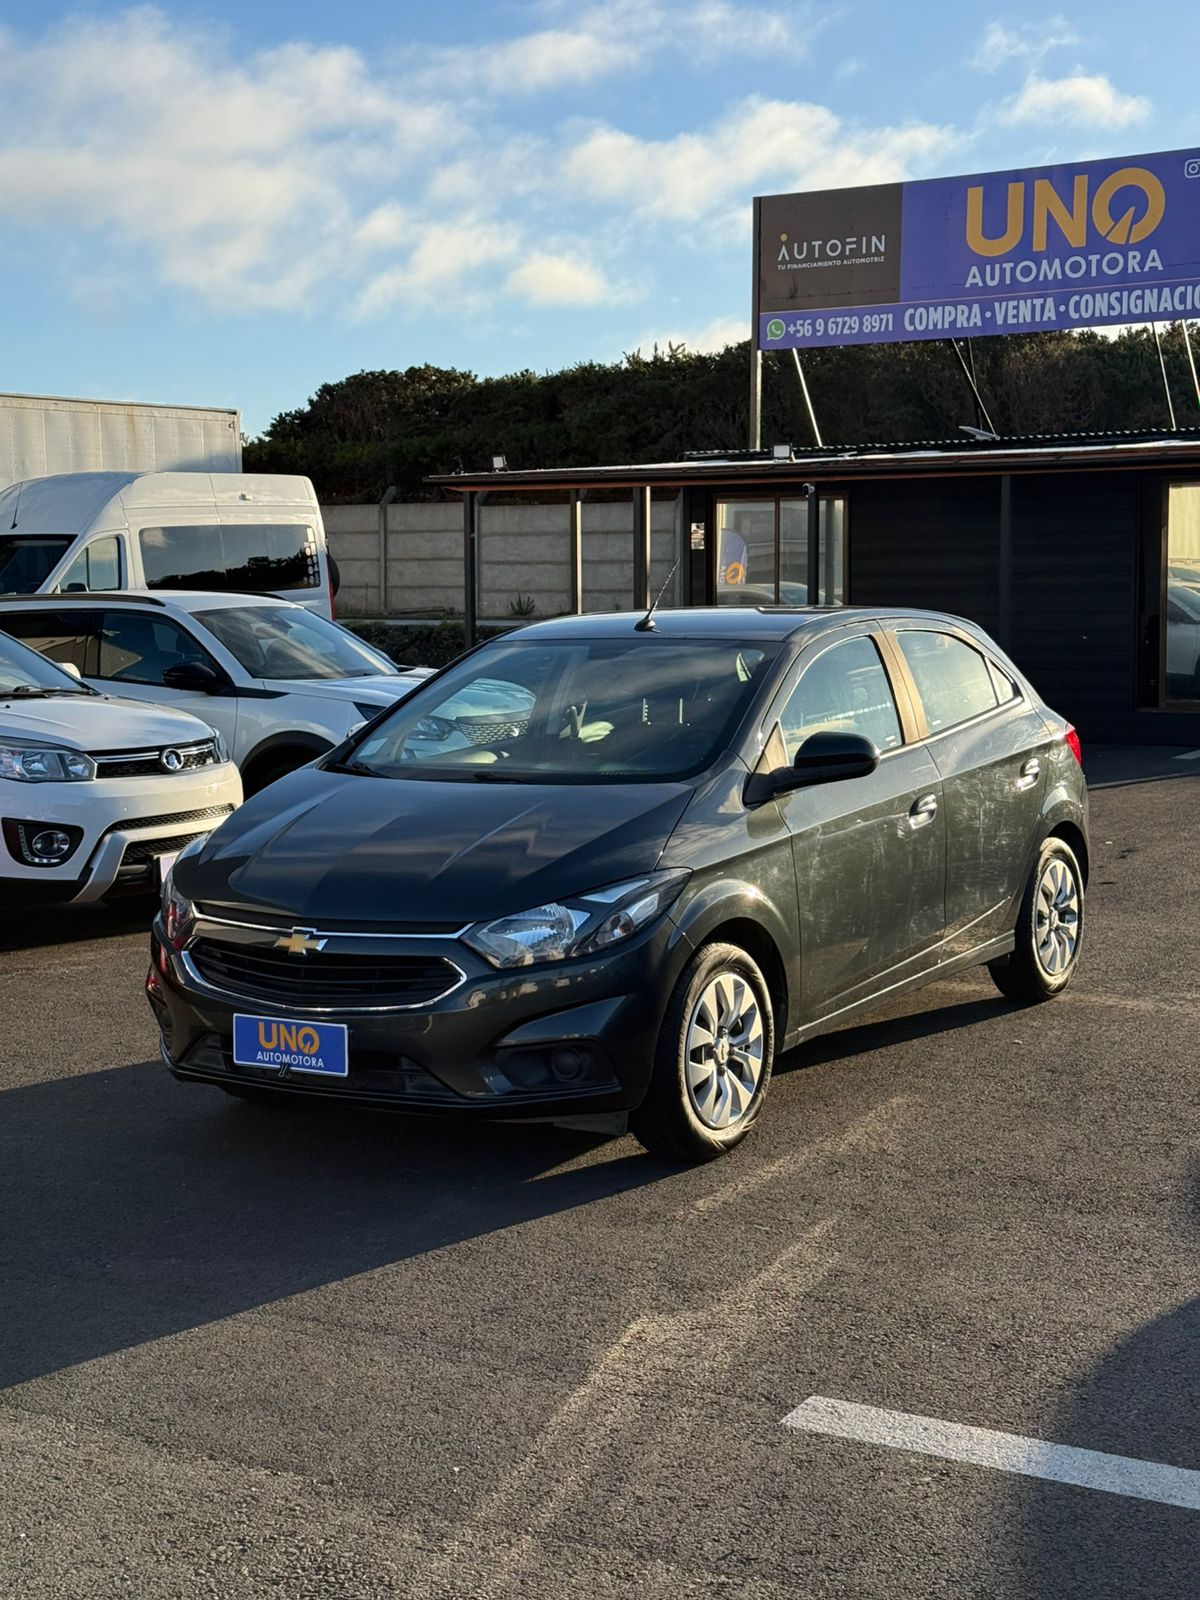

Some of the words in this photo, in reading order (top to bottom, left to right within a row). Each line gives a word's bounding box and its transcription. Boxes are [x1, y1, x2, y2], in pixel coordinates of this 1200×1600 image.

[966, 167, 1166, 257] UNO
[777, 233, 886, 261] AUTOFIN
[787, 260, 842, 270] FINANCIAMIENTO
[843, 256, 885, 265] AUTOMOTRIZ
[965, 249, 1164, 288] AUTOMOTORA
[787, 319, 812, 338] +56
[815, 318, 825, 336] 9
[827, 316, 860, 336] 6729
[862, 313, 893, 333] 8971
[904, 303, 982, 331] COMPRA
[994, 297, 1057, 325] VENTA
[258, 1021, 320, 1055] UNO
[256, 1051, 324, 1068] AUTOMOTORA
